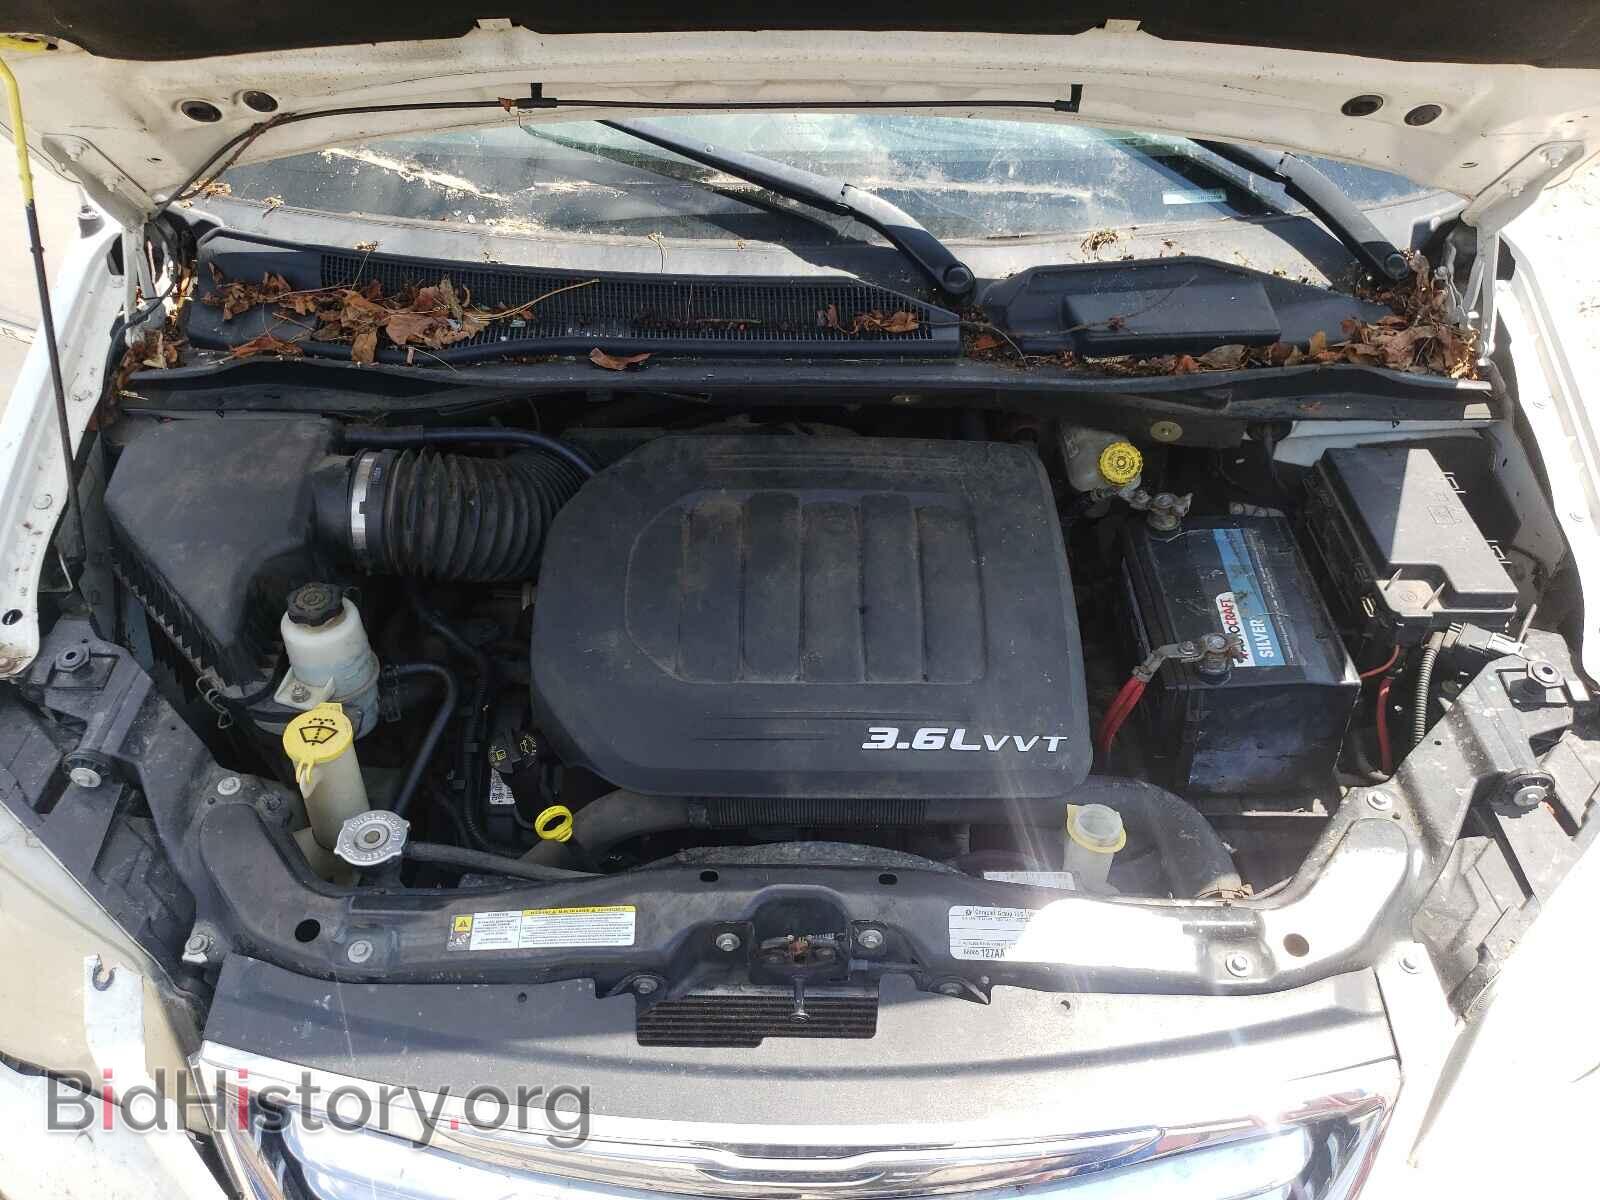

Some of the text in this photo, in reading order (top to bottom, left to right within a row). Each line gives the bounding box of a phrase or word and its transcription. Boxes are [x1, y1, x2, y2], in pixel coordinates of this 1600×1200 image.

[1250, 619, 1274, 658] SILVER
[861, 727, 1068, 752] 3.6L VVT
[980, 948, 1005, 958] 127AA
